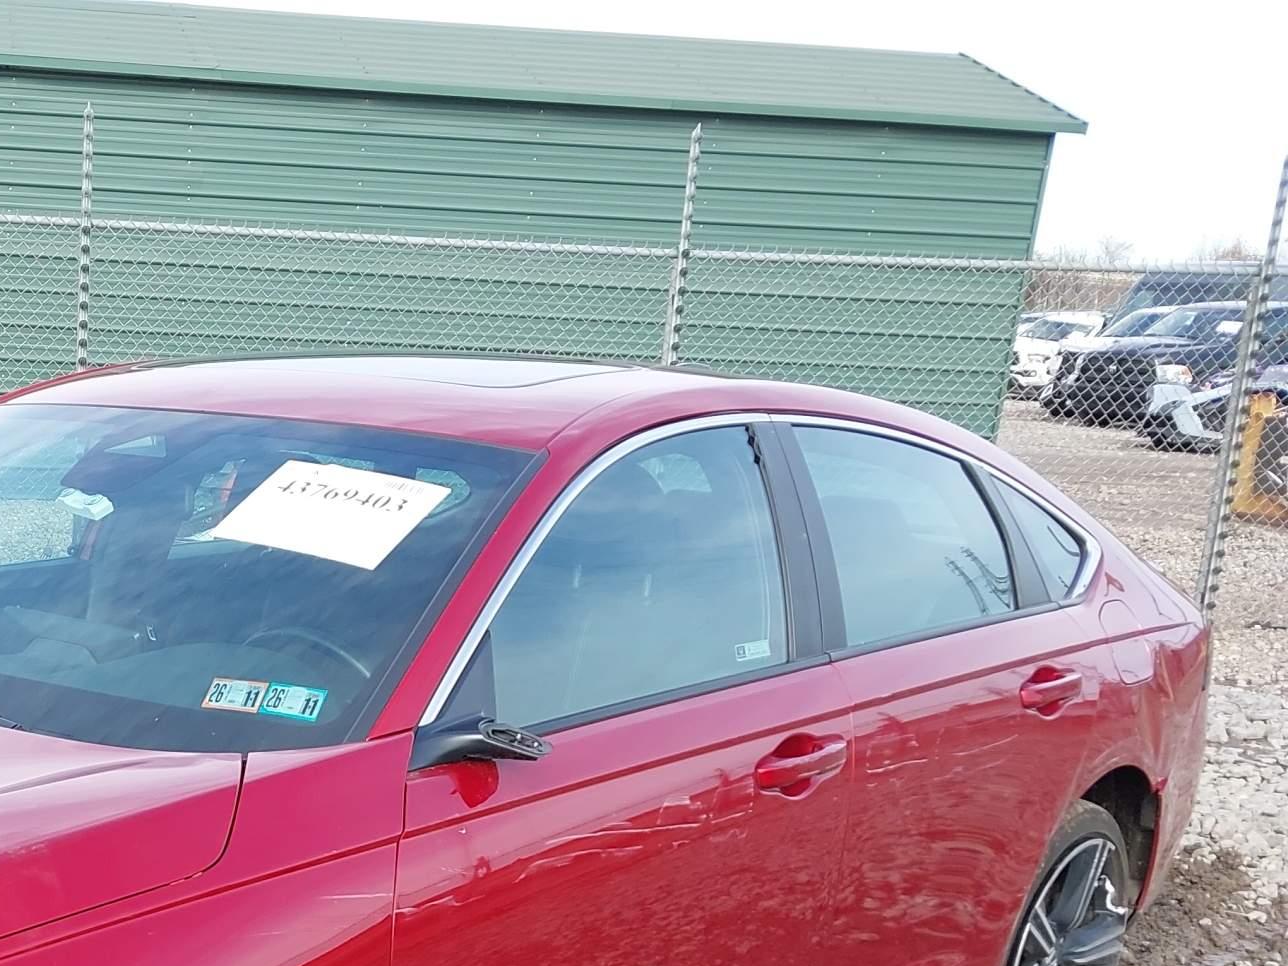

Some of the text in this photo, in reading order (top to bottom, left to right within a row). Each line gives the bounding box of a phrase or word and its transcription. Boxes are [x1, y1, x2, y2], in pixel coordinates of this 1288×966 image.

[277, 480, 408, 512] 43769403
[209, 682, 260, 708] 26 11
[265, 687, 320, 716] 26 11
